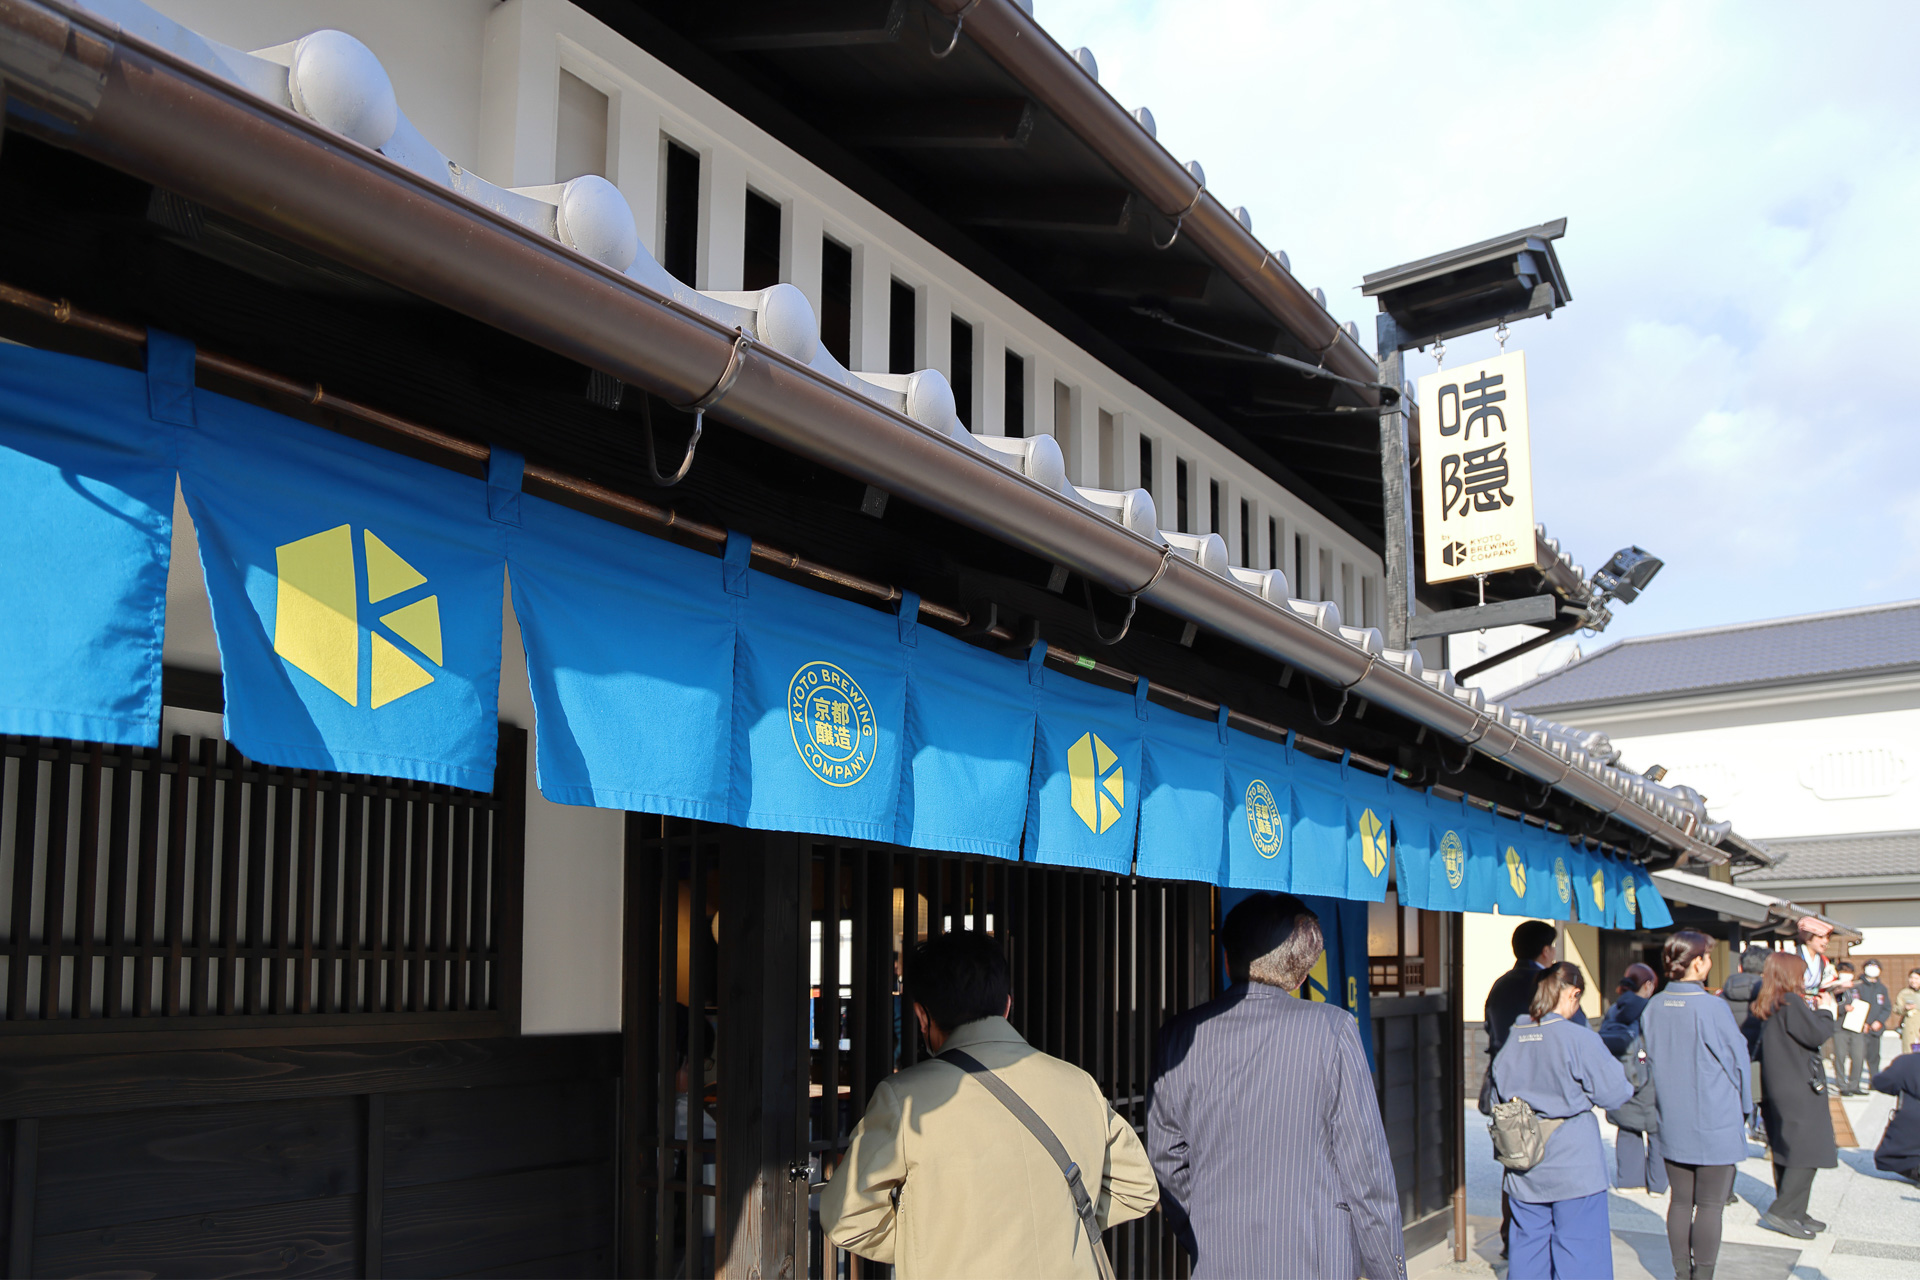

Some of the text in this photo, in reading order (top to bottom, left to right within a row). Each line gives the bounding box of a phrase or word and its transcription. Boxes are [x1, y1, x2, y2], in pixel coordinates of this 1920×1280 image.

[1470, 534, 1502, 545] KYOTO
[1470, 539, 1516, 554] BREWING
[1470, 547, 1518, 562] COMPANY
[792, 669, 873, 737] KYOTO BREWING
[812, 696, 850, 725] 京都
[804, 743, 867, 779] COMPANY
[1254, 832, 1280, 854] COMPANY
